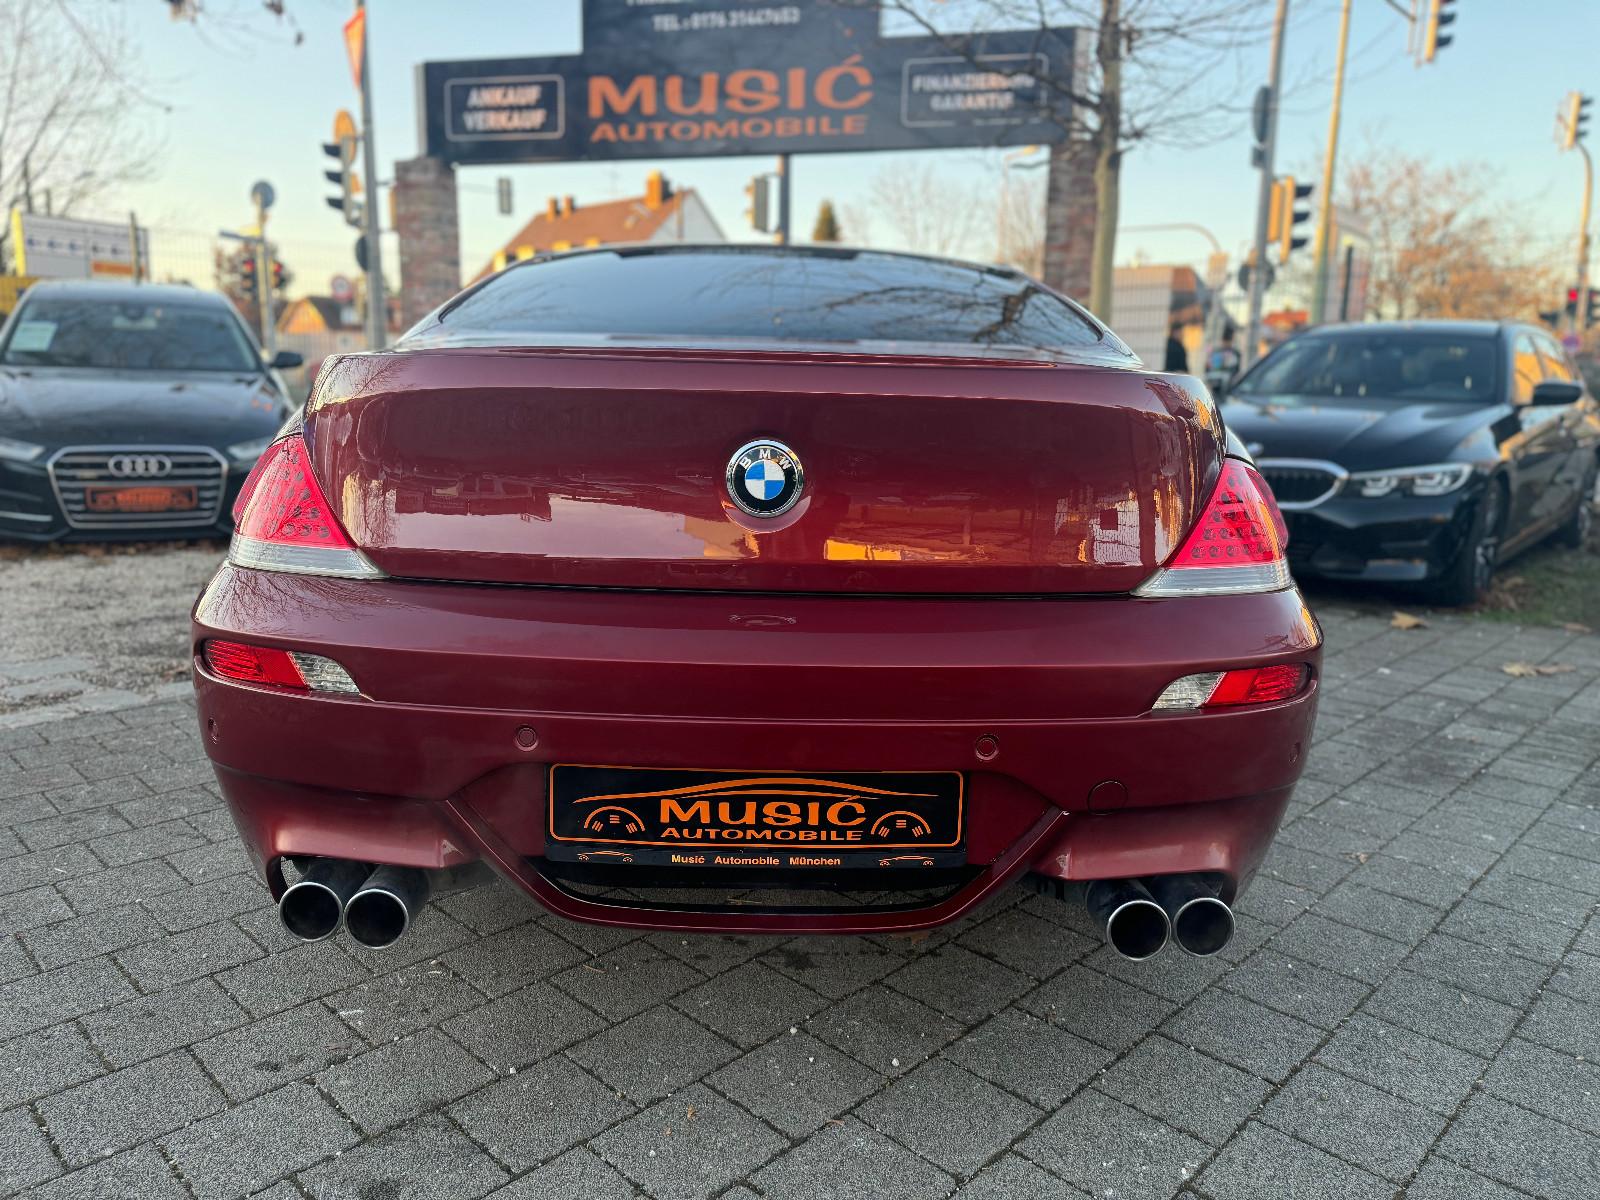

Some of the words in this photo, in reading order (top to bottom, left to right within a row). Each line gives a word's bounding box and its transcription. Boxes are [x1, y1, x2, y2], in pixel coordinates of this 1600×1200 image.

[467, 84, 542, 109] ANKAUF
[588, 54, 874, 119] MUSIĆ
[463, 108, 547, 132] VERKAUF
[590, 114, 869, 143] AUTOMOBILE
[739, 448, 792, 470] BMW
[660, 795, 867, 827] MUSIĆ
[660, 826, 864, 842] AUTOMOBILE
[671, 854, 705, 865] Musić
[714, 855, 780, 866] Automobile
[789, 856, 841, 867] München
